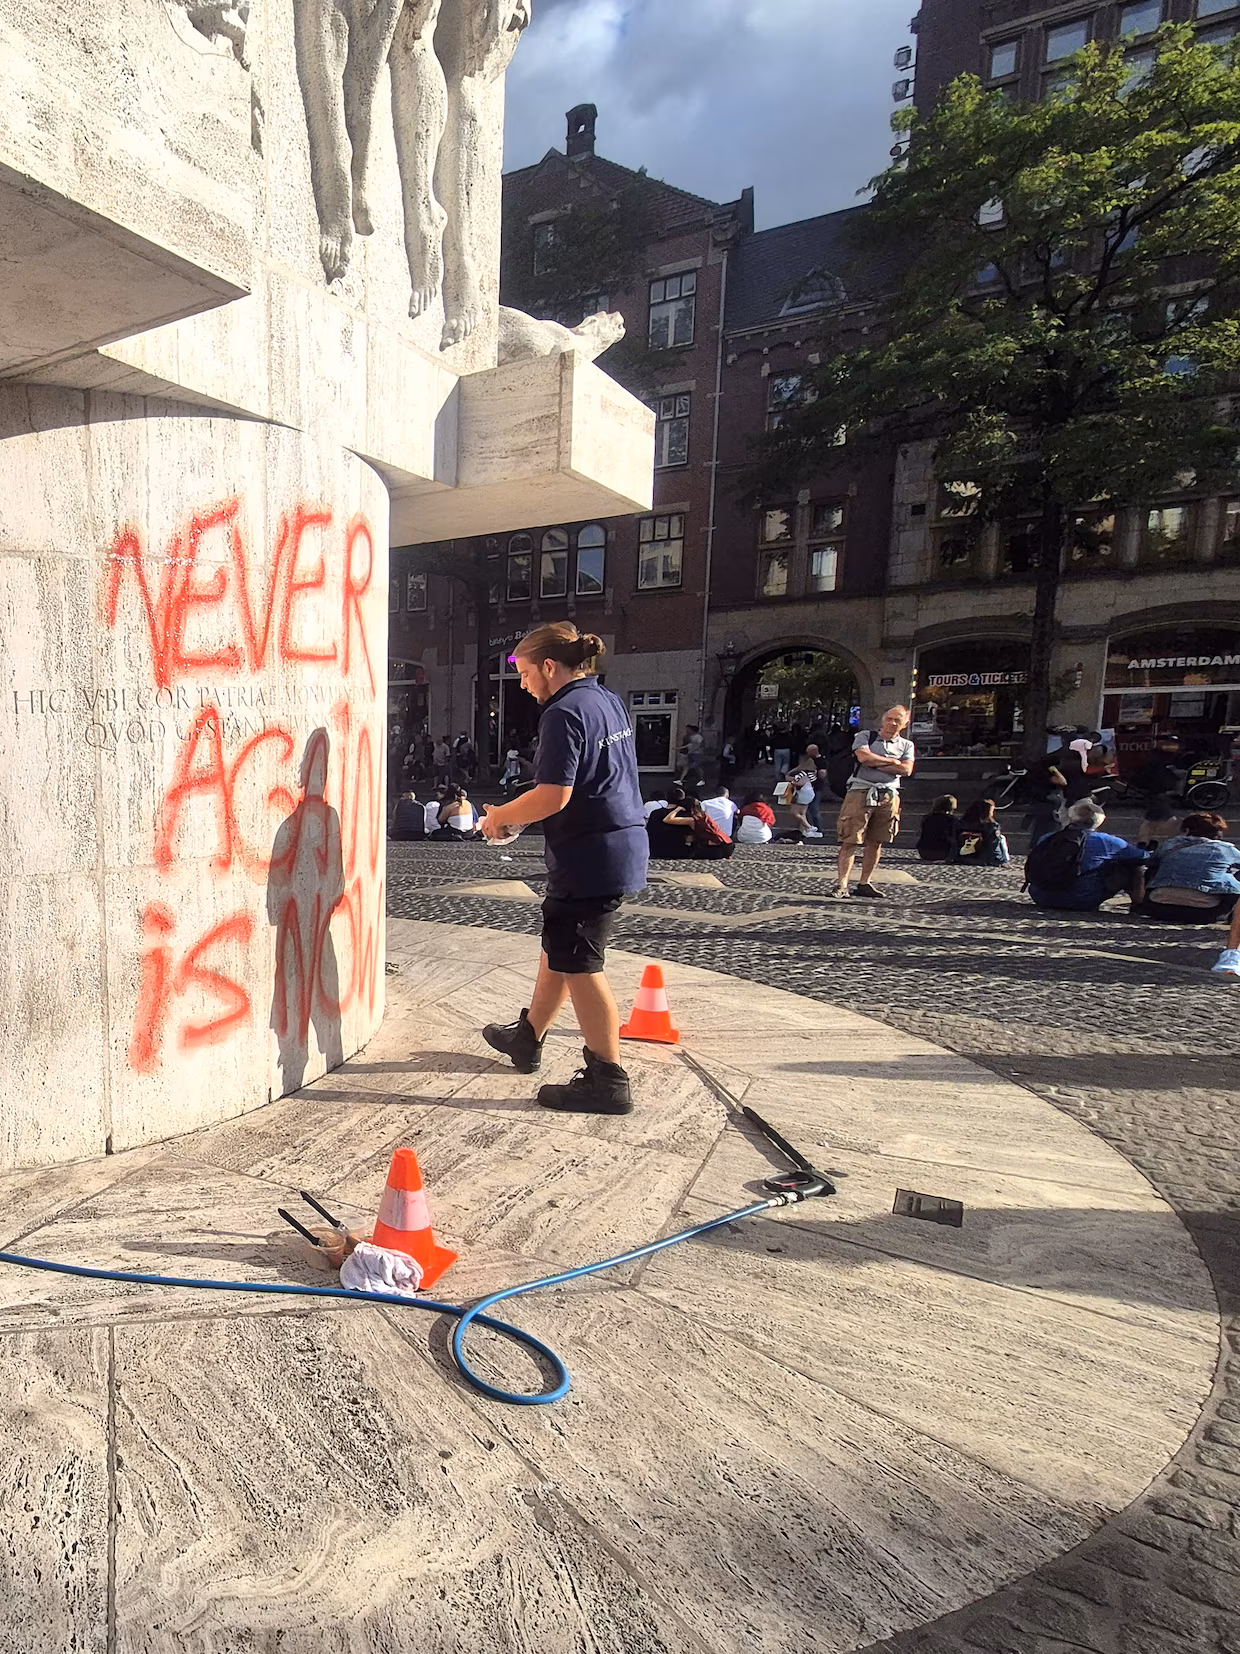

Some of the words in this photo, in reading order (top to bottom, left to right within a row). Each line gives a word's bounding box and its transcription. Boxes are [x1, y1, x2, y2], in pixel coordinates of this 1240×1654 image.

[105, 499, 376, 689] NEVER
[1127, 655, 1240, 669] AMSTERDAM
[929, 674, 968, 686] TOURS
[969, 673, 979, 685] &
[13, 688, 66, 715] HIC
[79, 687, 126, 712] VBI
[137, 686, 191, 711] COR
[198, 685, 277, 709] PATRIAE
[84, 721, 166, 752] QVOD
